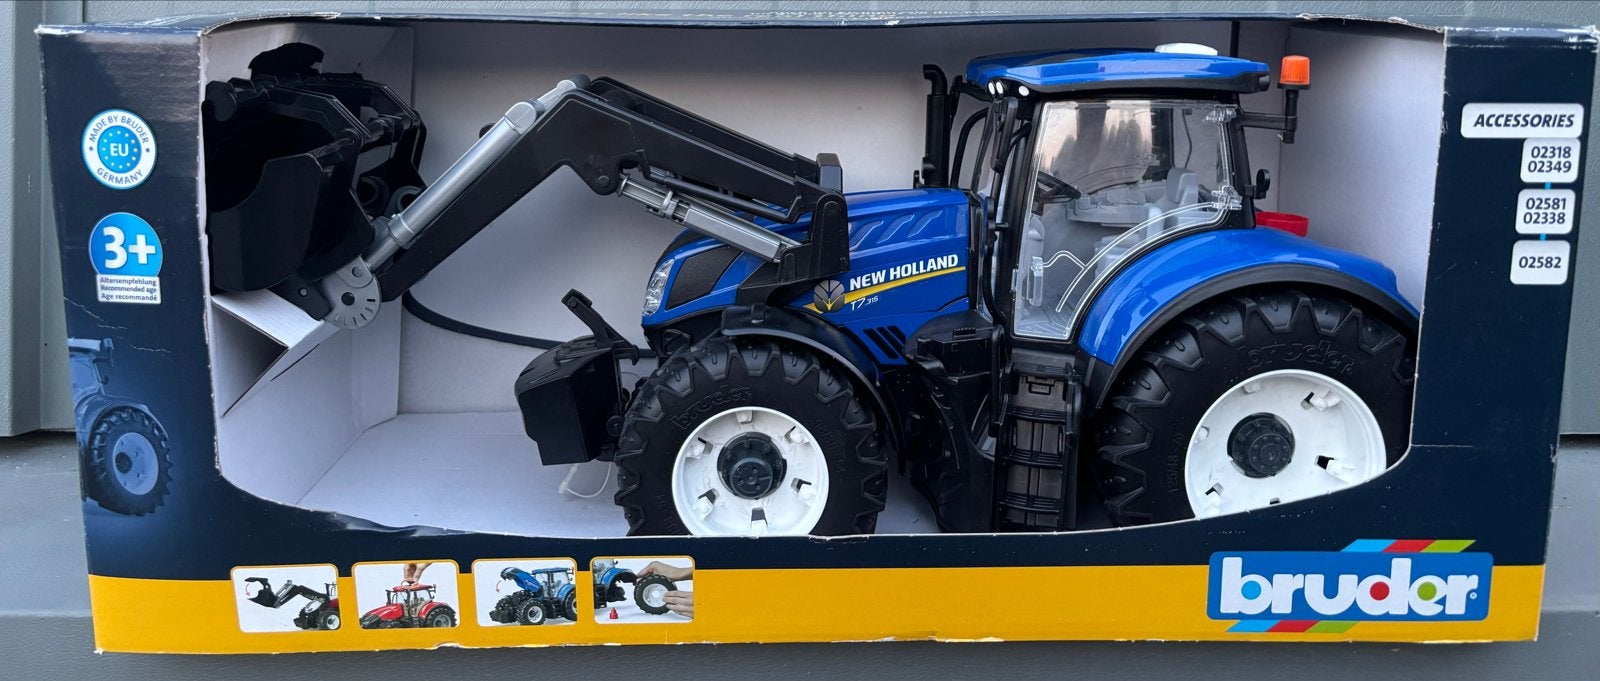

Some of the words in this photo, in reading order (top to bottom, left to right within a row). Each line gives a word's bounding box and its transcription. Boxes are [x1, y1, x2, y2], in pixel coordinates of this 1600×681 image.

[1473, 114, 1575, 127] ACCESSORIES
[89, 118, 107, 143] MADE
[107, 115, 119, 124] BY
[120, 115, 149, 143] BRUDER
[109, 143, 129, 157] EU
[1531, 146, 1572, 159] 02318
[1528, 160, 1572, 173] 02349
[97, 168, 143, 185] GERMANY
[1526, 198, 1567, 210] 02581
[1523, 212, 1566, 224] 02338
[102, 226, 157, 269] 3+
[1519, 256, 1562, 269] 02582
[850, 269, 886, 291] NEW
[889, 254, 959, 282] HOLLAND
[100, 277, 157, 287] Altersempfehlung
[101, 285, 145, 293] Recommended
[1219, 557, 1479, 616] bruder
